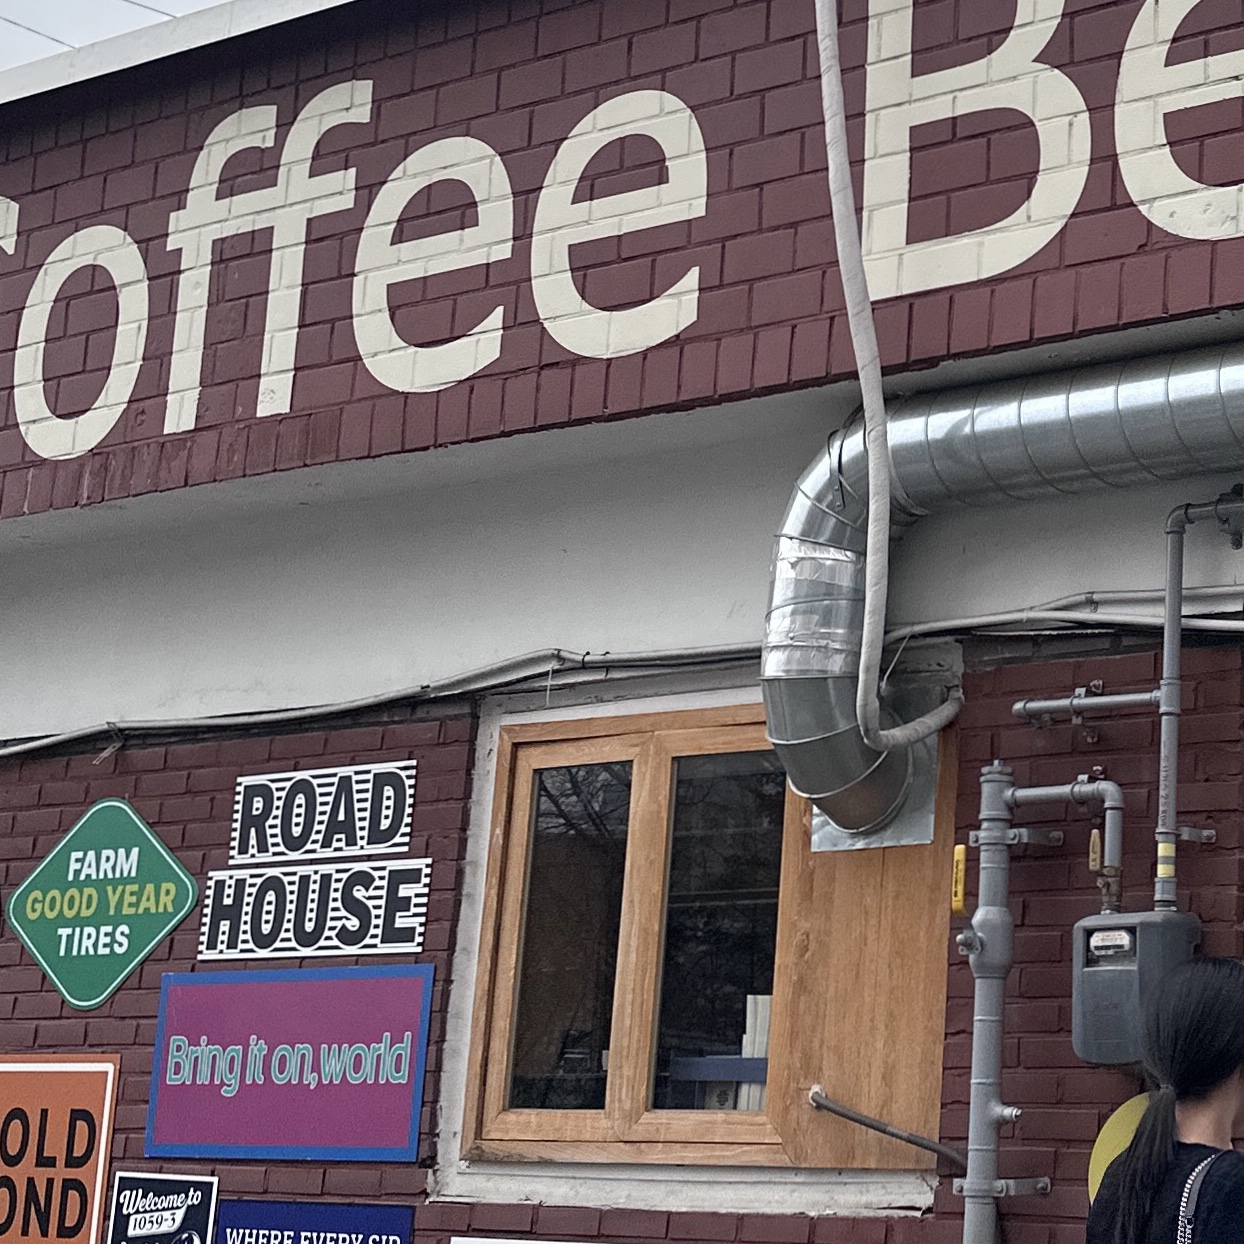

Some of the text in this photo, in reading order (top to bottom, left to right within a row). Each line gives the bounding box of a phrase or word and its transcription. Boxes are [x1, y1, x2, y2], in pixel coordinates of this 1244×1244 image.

[0, 79, 708, 461] offee
[237, 769, 408, 857] ROAD
[67, 846, 140, 882] FARM
[25, 882, 176, 921] GOOD YEAR
[205, 866, 424, 953] HOUSE
[57, 924, 131, 956] TIRES
[166, 1035, 242, 1097] Bring
[245, 1034, 268, 1084] it
[119, 1187, 202, 1215] Welcome to
[132, 1211, 177, 1232] 1059-3
